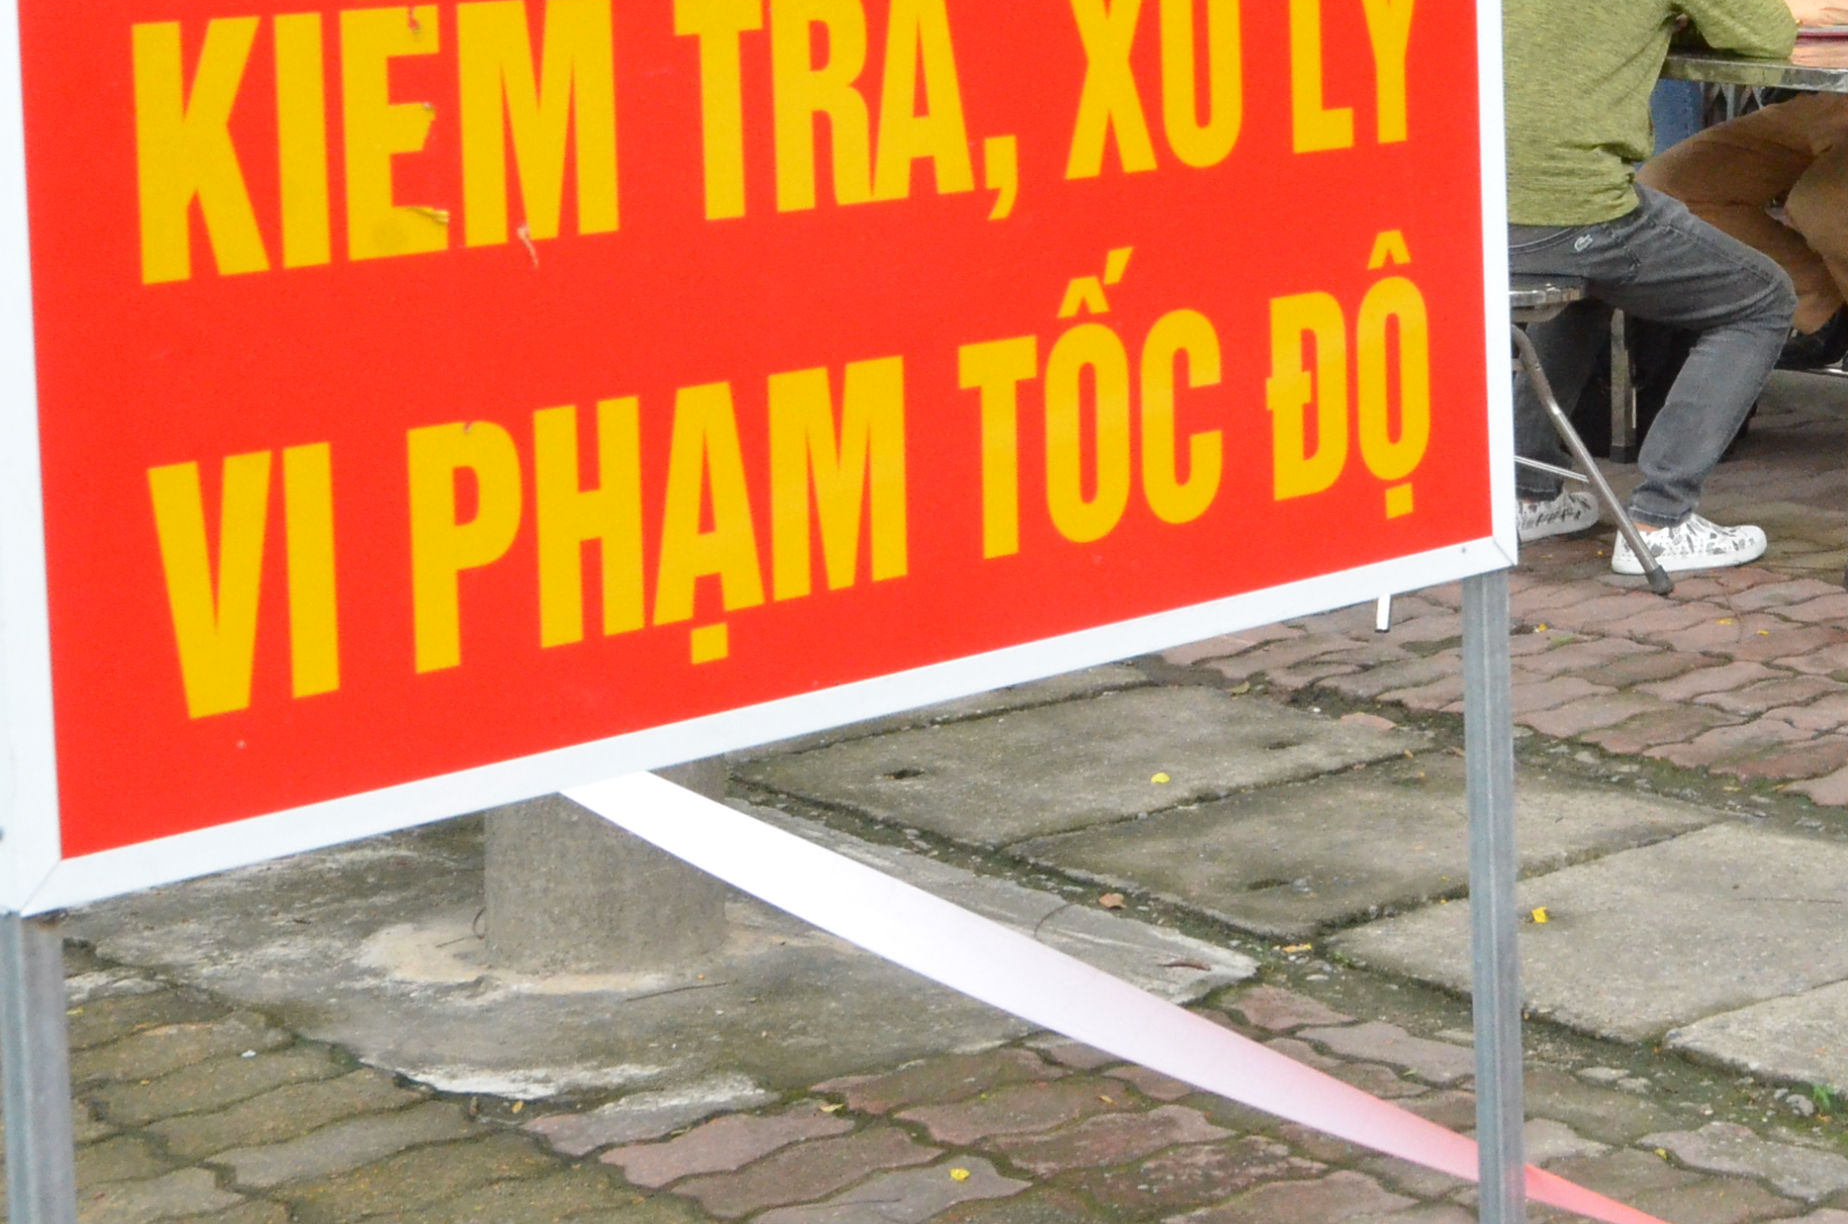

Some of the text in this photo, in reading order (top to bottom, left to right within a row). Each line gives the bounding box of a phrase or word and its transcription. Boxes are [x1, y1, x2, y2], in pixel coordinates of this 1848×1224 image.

[148, 229, 1431, 719] VI PHẠM TỐC ĐỘ
